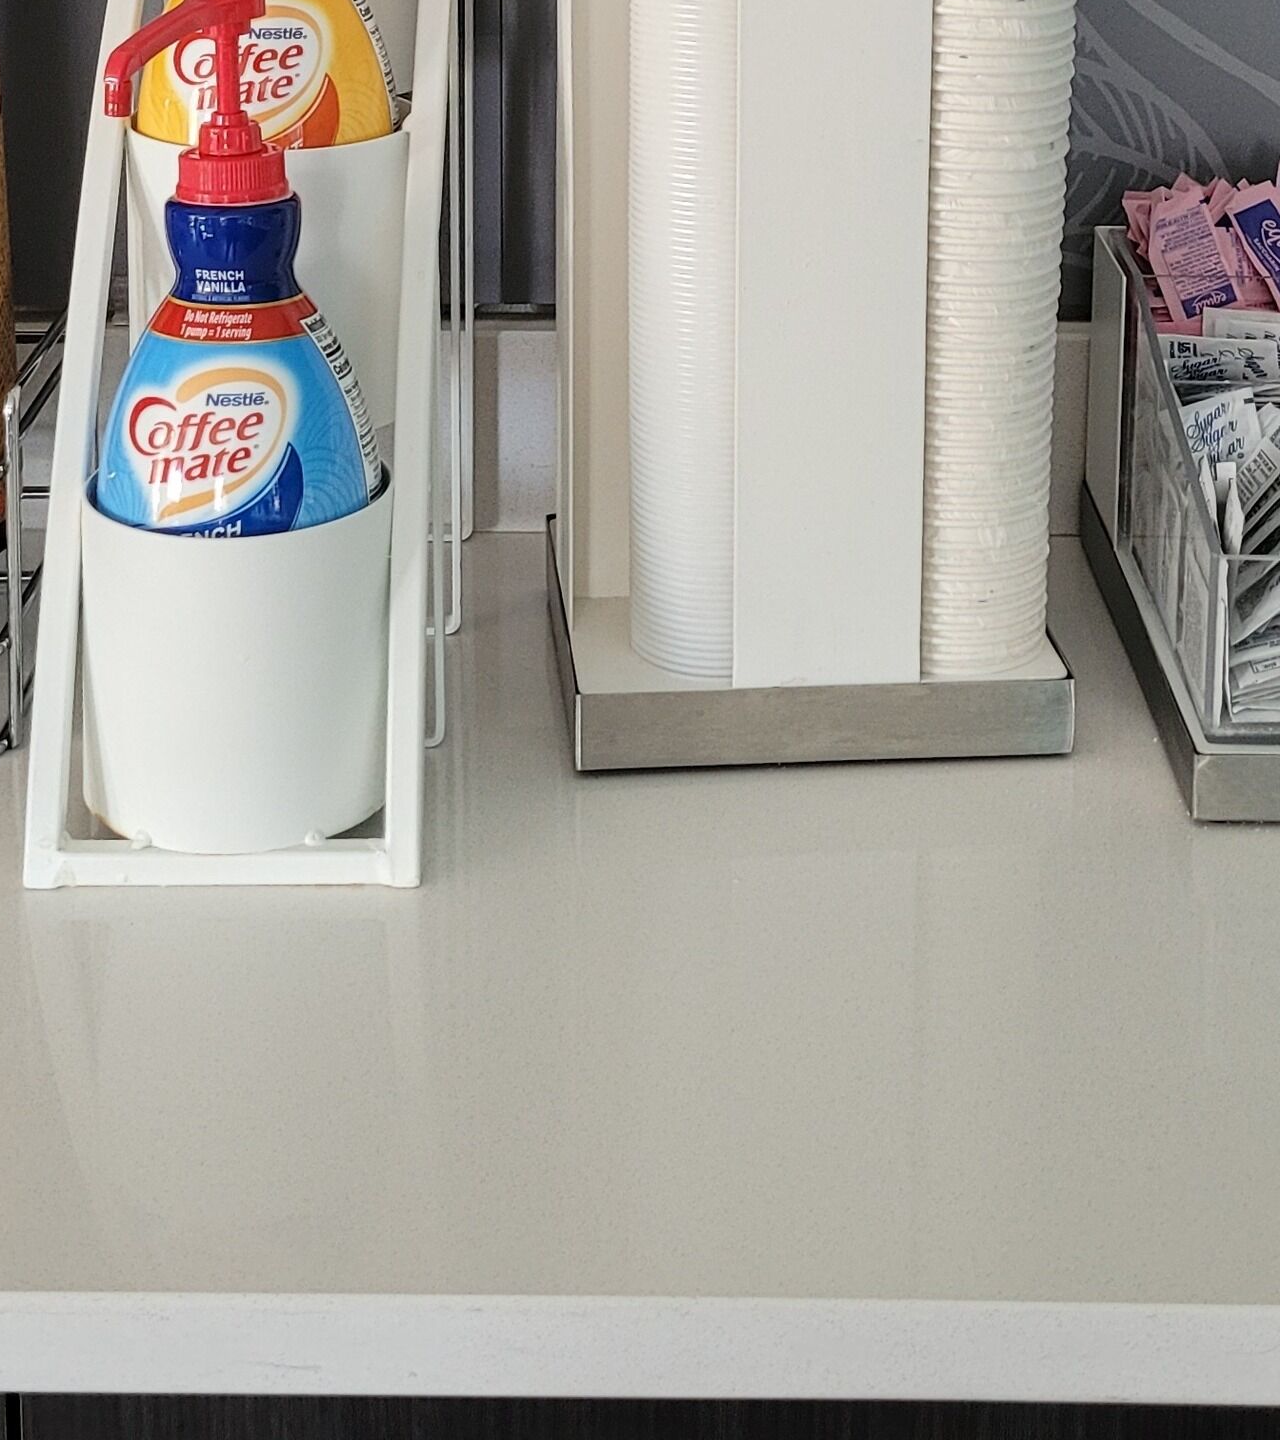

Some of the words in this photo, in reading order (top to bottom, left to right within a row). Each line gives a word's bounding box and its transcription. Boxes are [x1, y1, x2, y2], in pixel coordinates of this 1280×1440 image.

[195, 269, 245, 281] FRENCH
[196, 280, 246, 293] VANILLA
[184, 309, 195, 322] Do
[194, 310, 209, 323] Not
[209, 311, 253, 327] Refrigerate
[180, 323, 186, 336] 1
[184, 326, 208, 340] pump
[215, 325, 221, 338] 1
[221, 326, 253, 340] serving
[206, 391, 265, 407] Nestlé
[129, 396, 264, 456] Coffee
[1186, 401, 1231, 439] Sugar
[149, 445, 252, 485] mate
